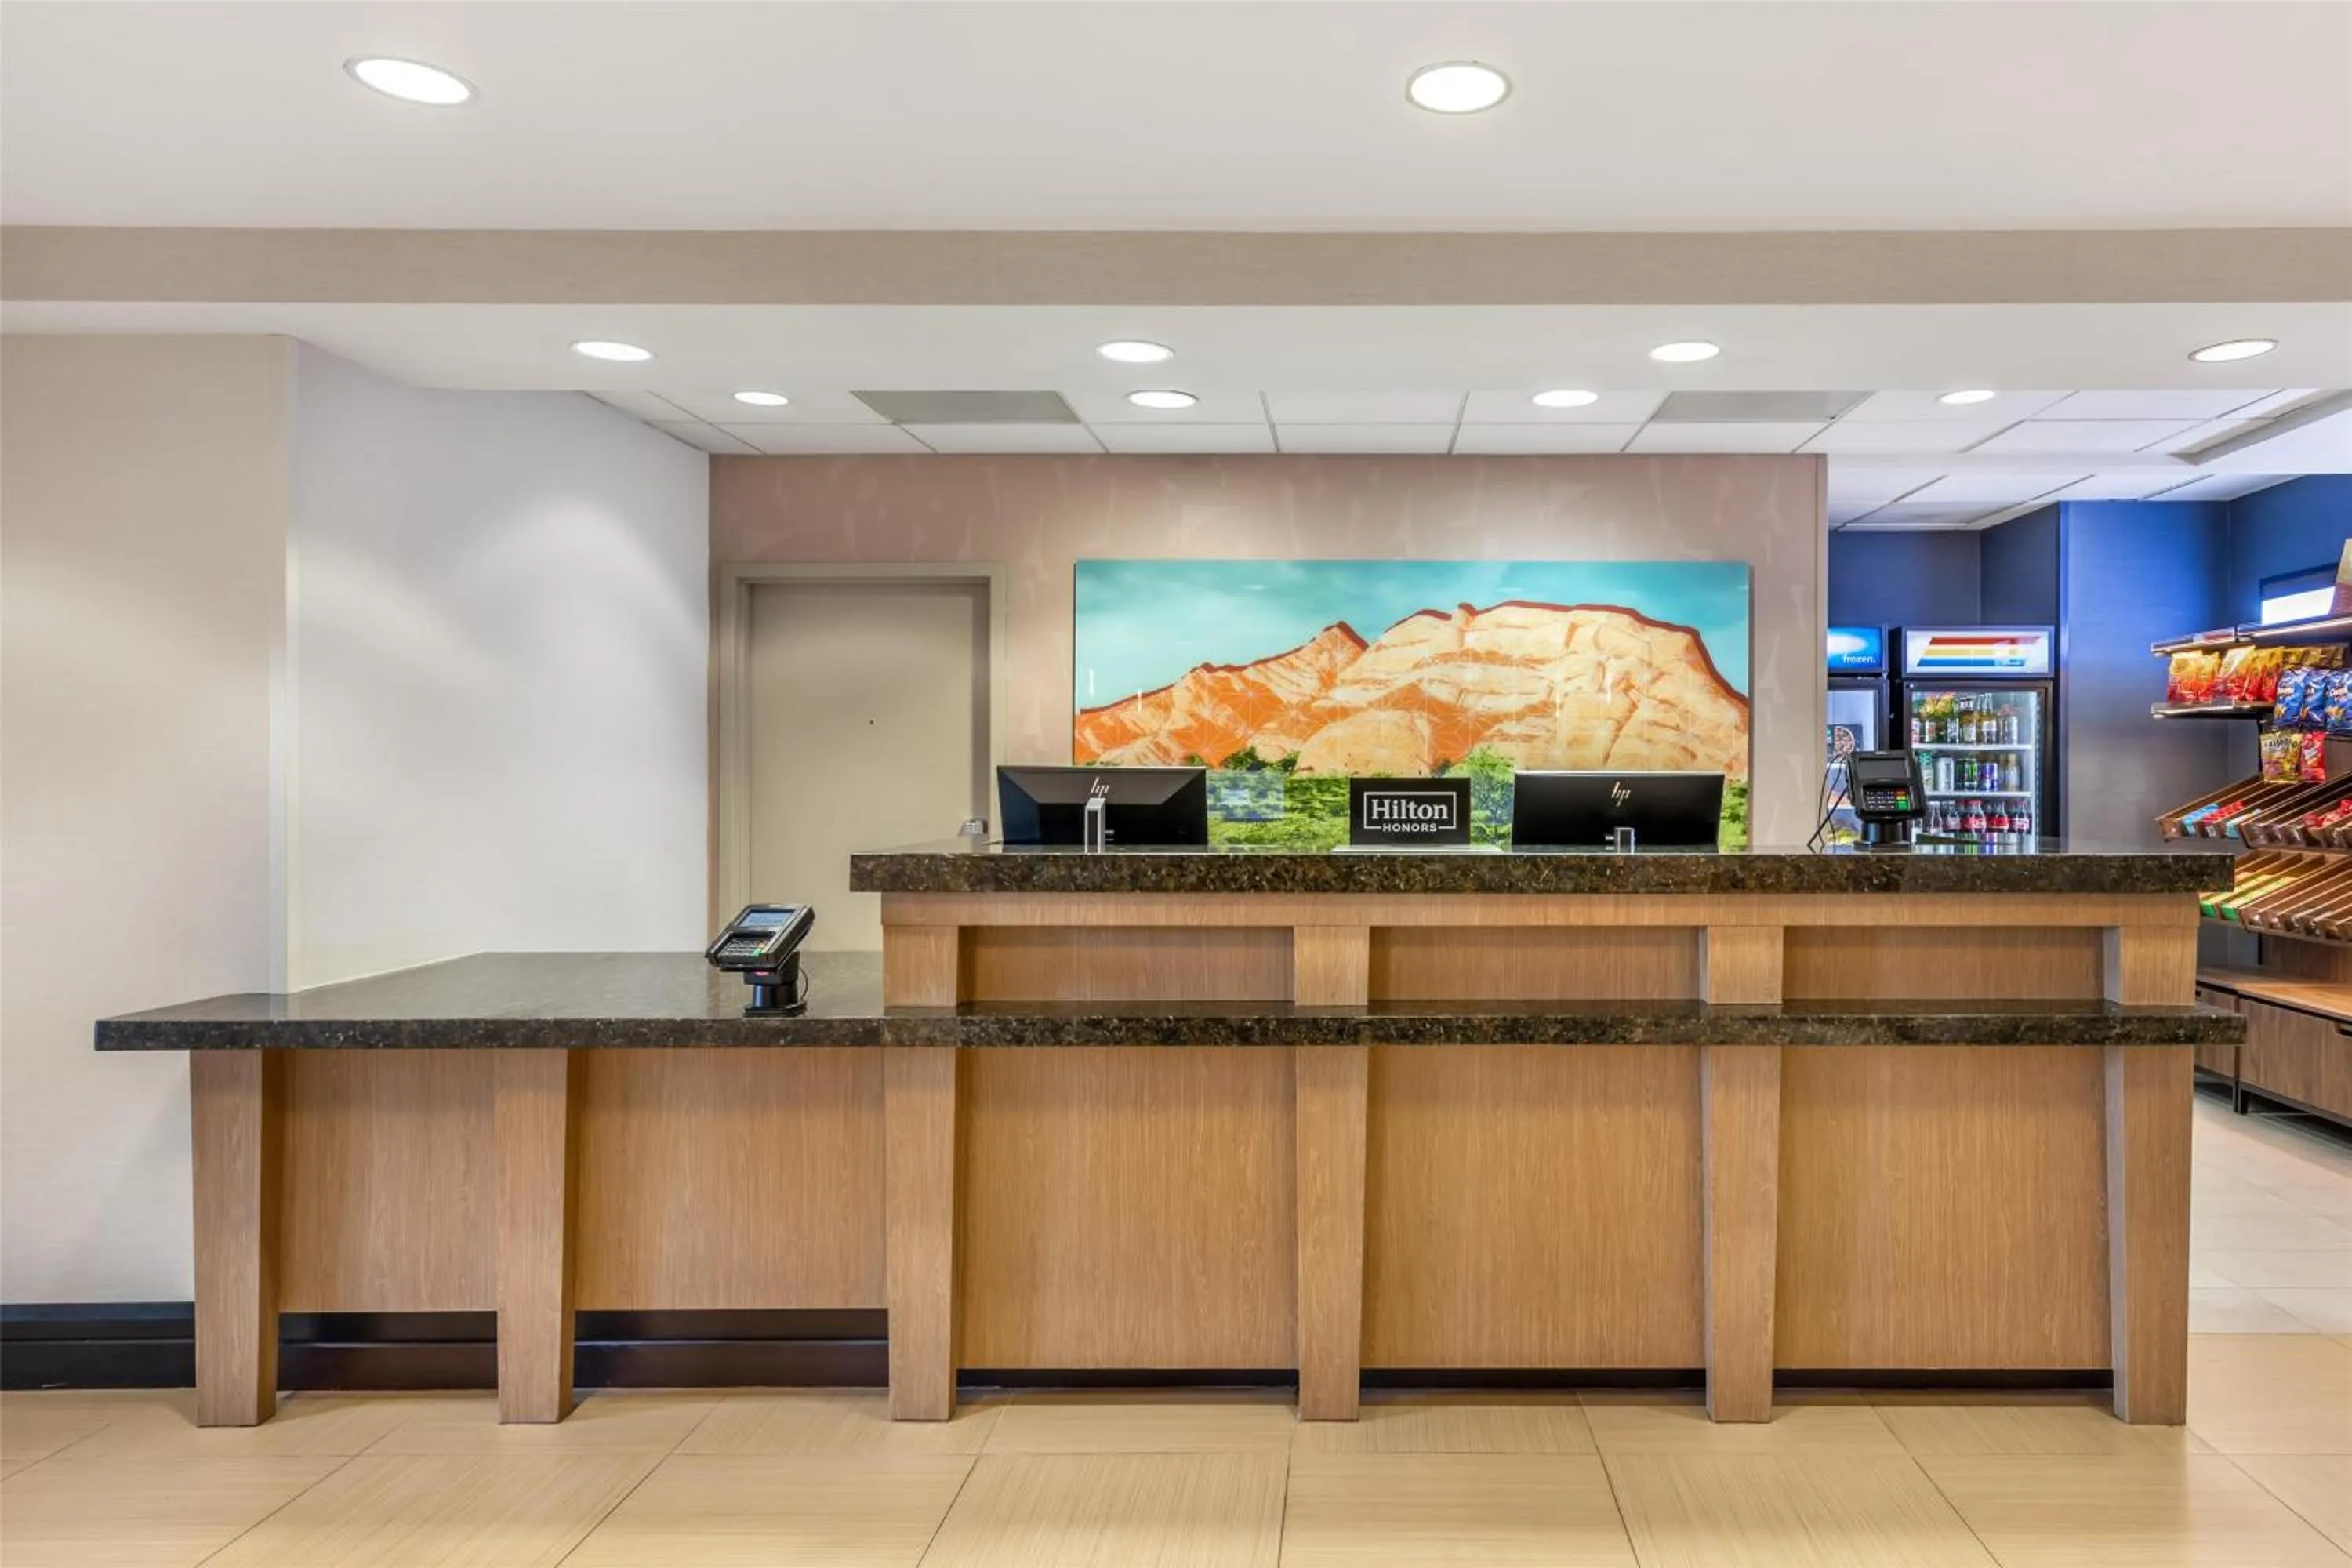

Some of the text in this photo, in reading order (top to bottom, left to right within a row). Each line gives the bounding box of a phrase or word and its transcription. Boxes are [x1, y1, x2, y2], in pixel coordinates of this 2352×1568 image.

[1091, 777, 1109, 798] hp
[1611, 781, 1631, 807] hp
[1371, 799, 1449, 820] Hilton
[1382, 822, 1437, 832] HONORS
